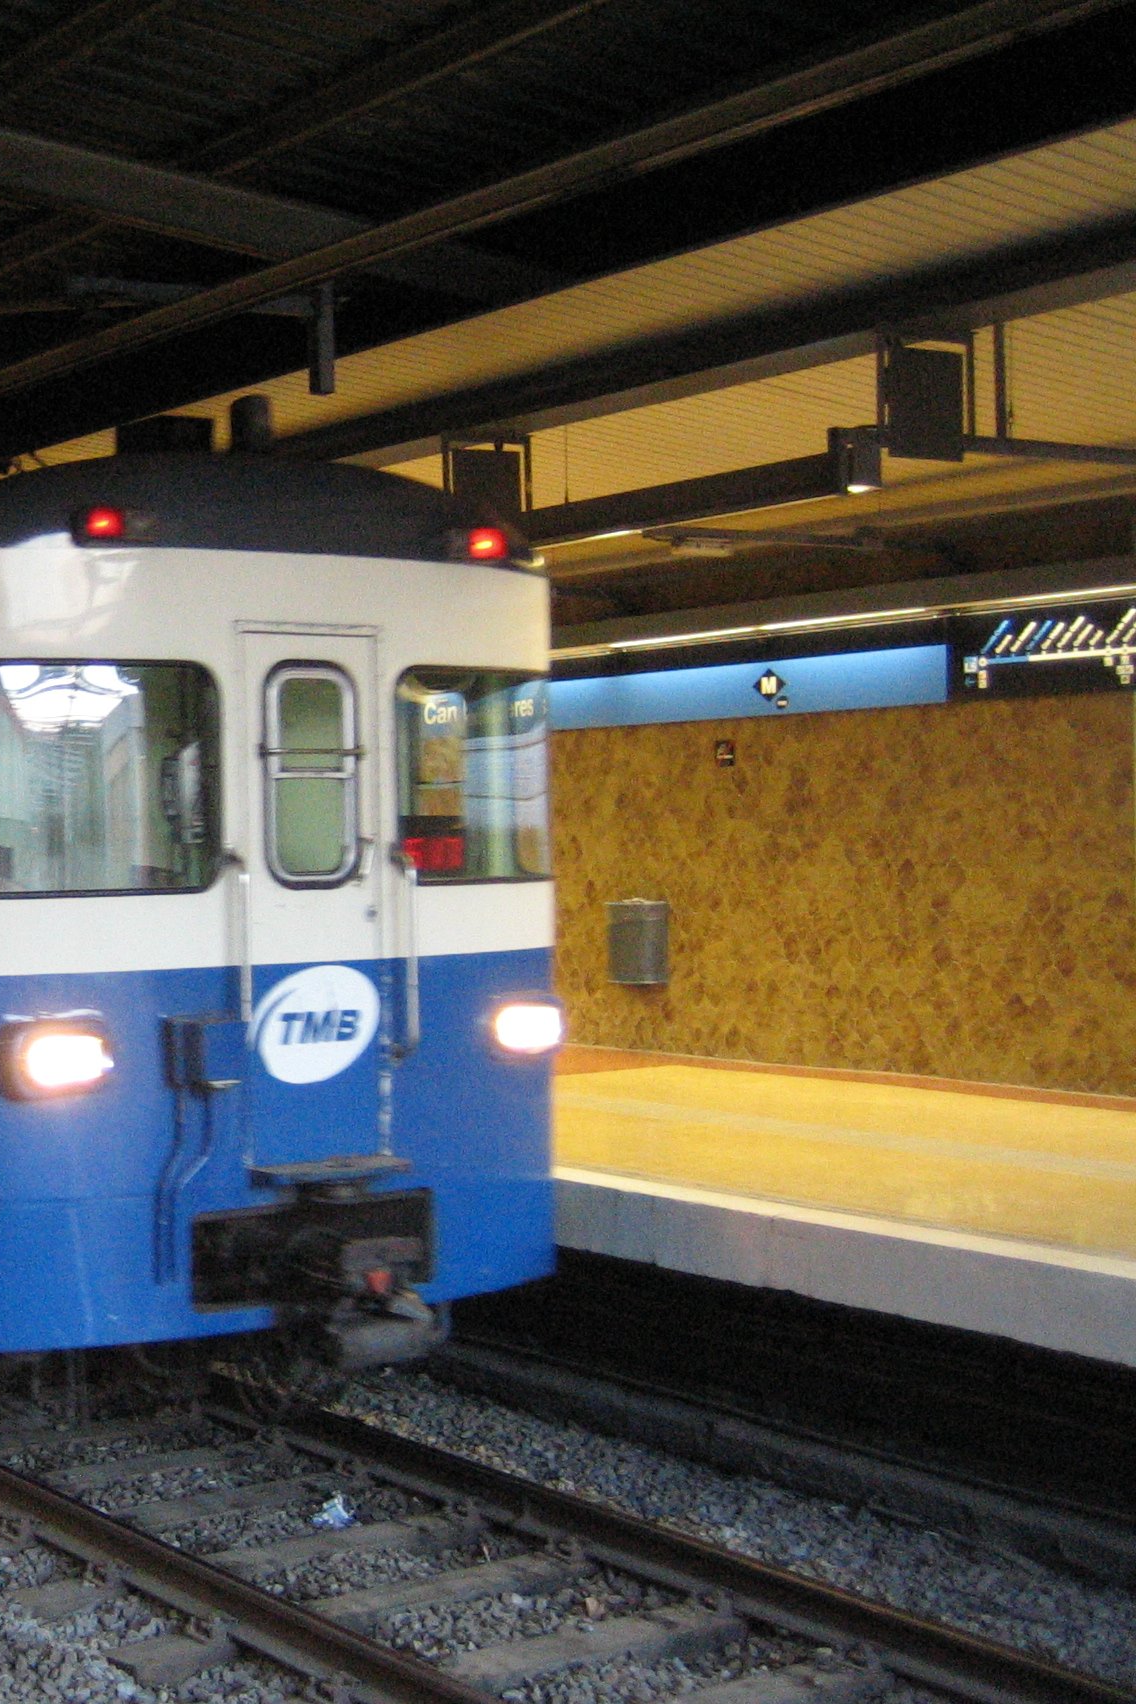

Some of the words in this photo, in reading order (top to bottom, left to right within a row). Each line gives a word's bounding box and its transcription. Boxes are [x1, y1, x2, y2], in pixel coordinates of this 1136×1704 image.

[760, 676, 777, 694] M
[423, 702, 458, 724] Can
[280, 1009, 360, 1045] TMB
